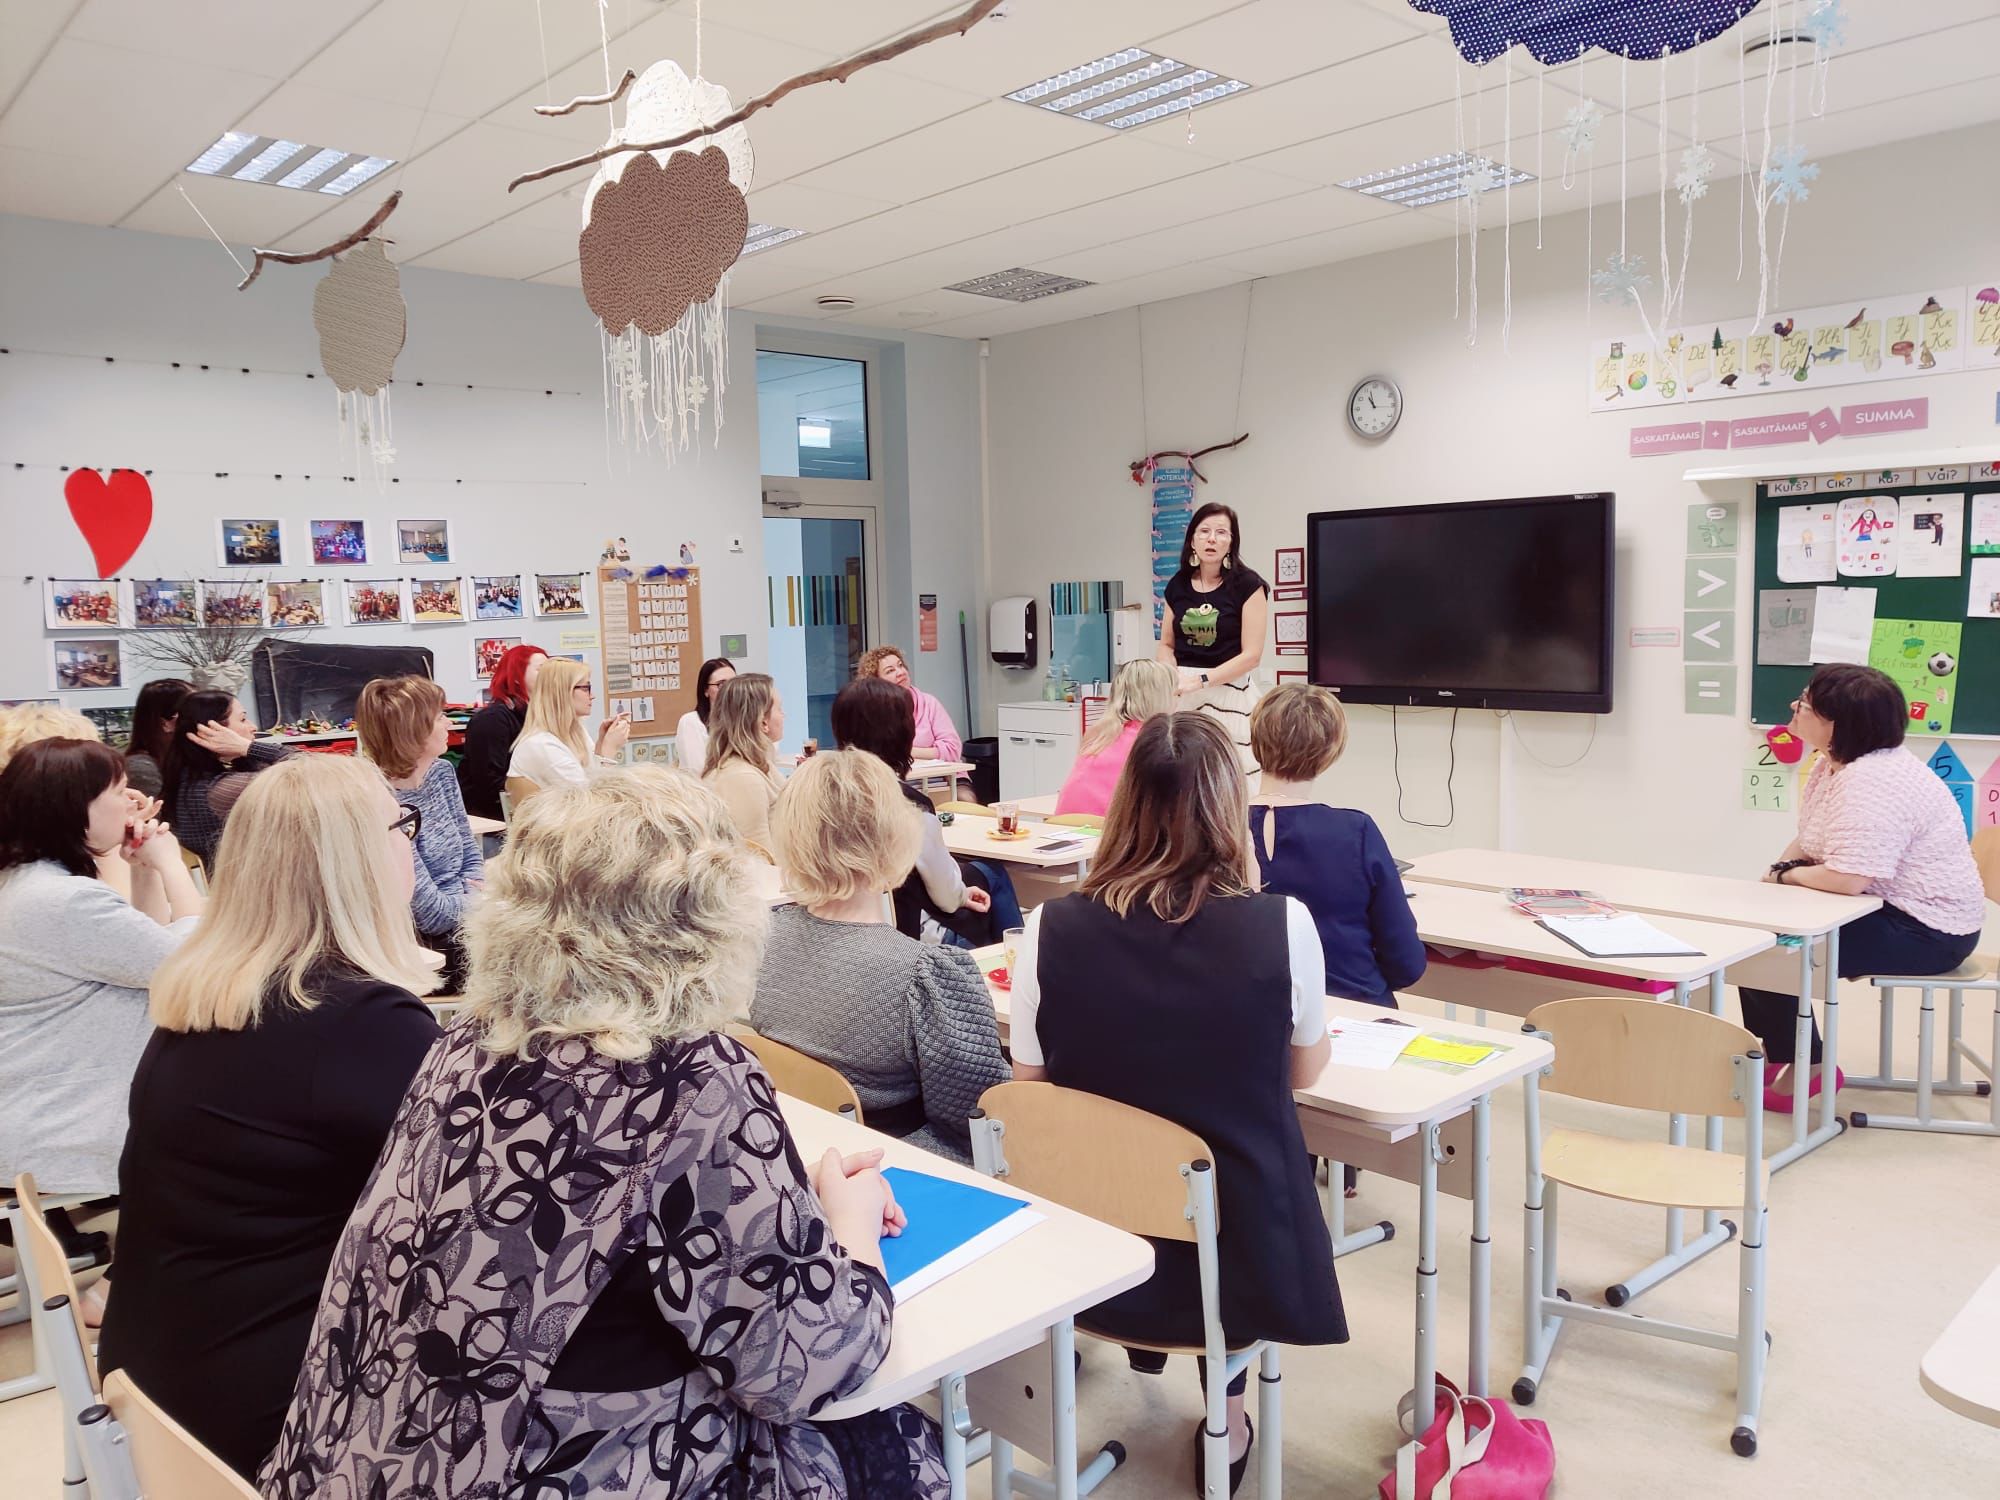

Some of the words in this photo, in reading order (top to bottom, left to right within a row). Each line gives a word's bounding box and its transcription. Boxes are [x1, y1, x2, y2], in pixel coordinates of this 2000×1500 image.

[1734, 421, 1808, 437] SASKAITĀMAIS
[1855, 407, 1915, 424] SUMMA
[1826, 476, 1853, 489] Cik?
[1927, 468, 1958, 481] Vai?
[1758, 744, 1778, 766] 2
[1935, 755, 1953, 778] 5
[1750, 775, 1759, 786] 0
[1772, 776, 1783, 788] 2
